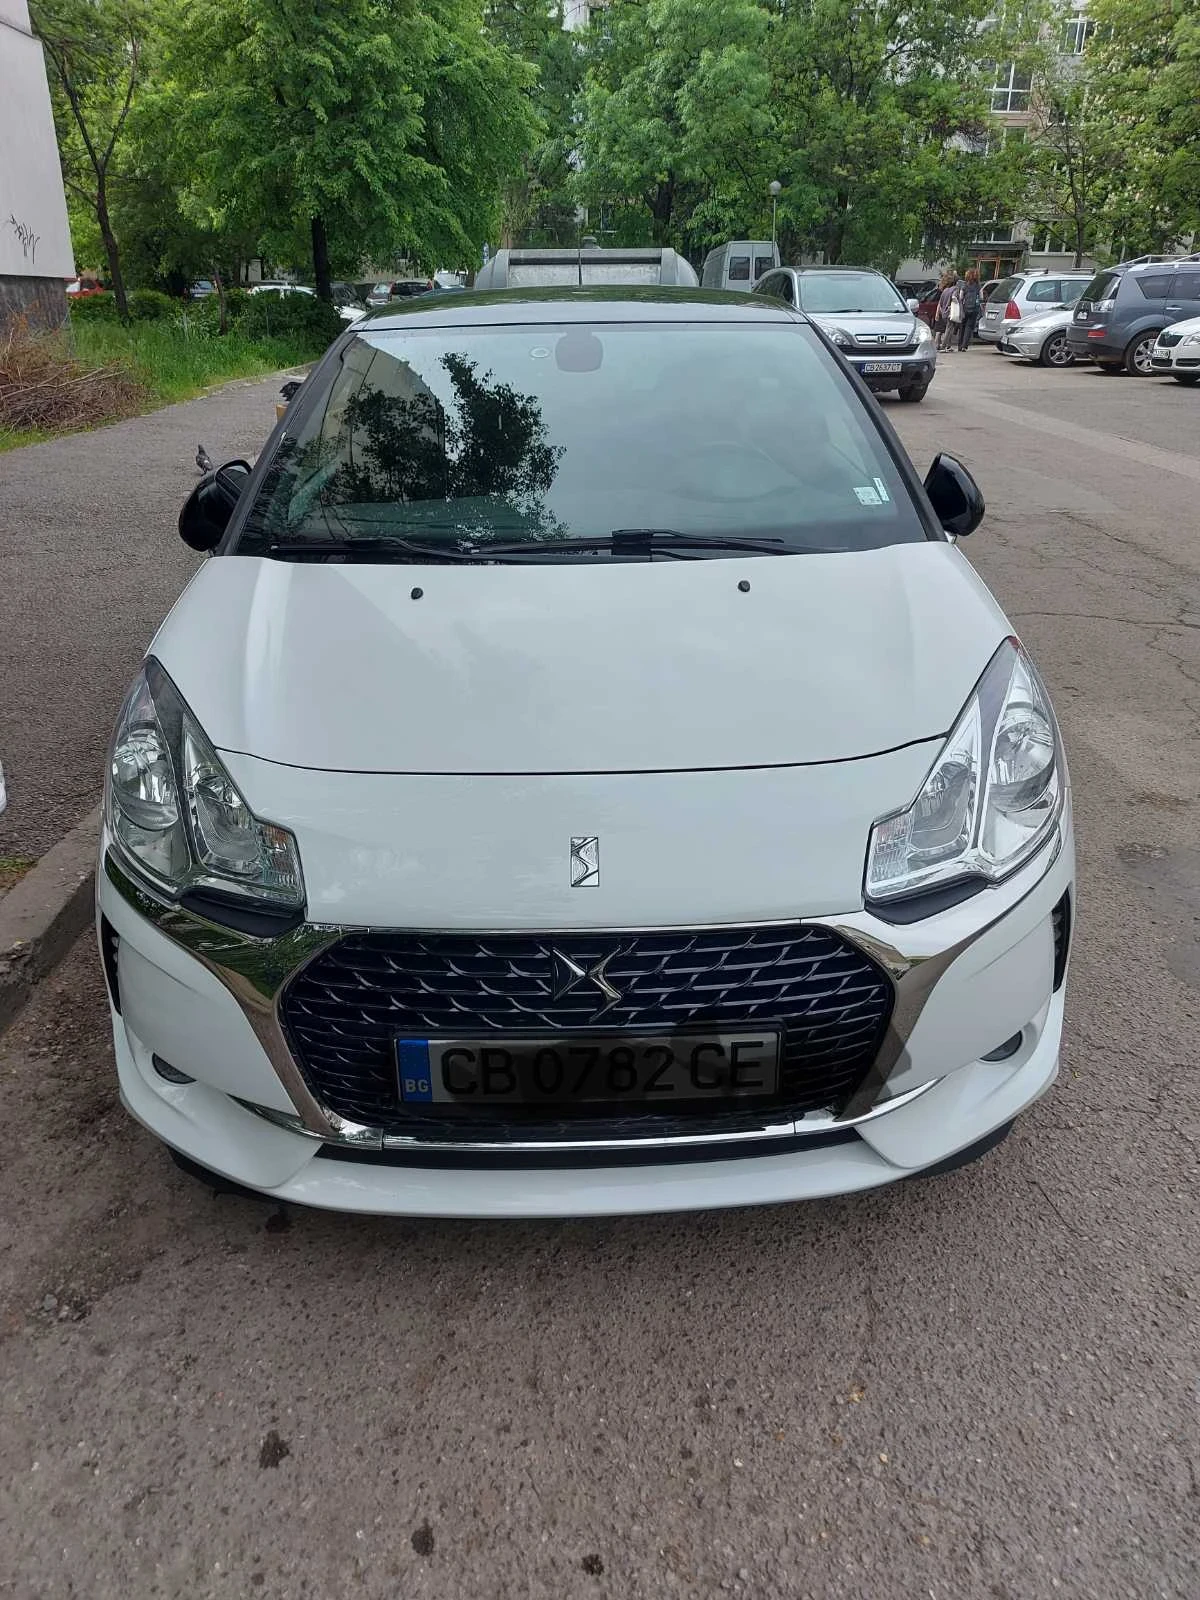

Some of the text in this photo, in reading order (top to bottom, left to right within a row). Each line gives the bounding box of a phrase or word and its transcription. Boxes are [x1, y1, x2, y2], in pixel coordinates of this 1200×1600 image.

[441, 1041, 764, 1095] CB 0782 CE
[405, 1079, 430, 1093] BG
